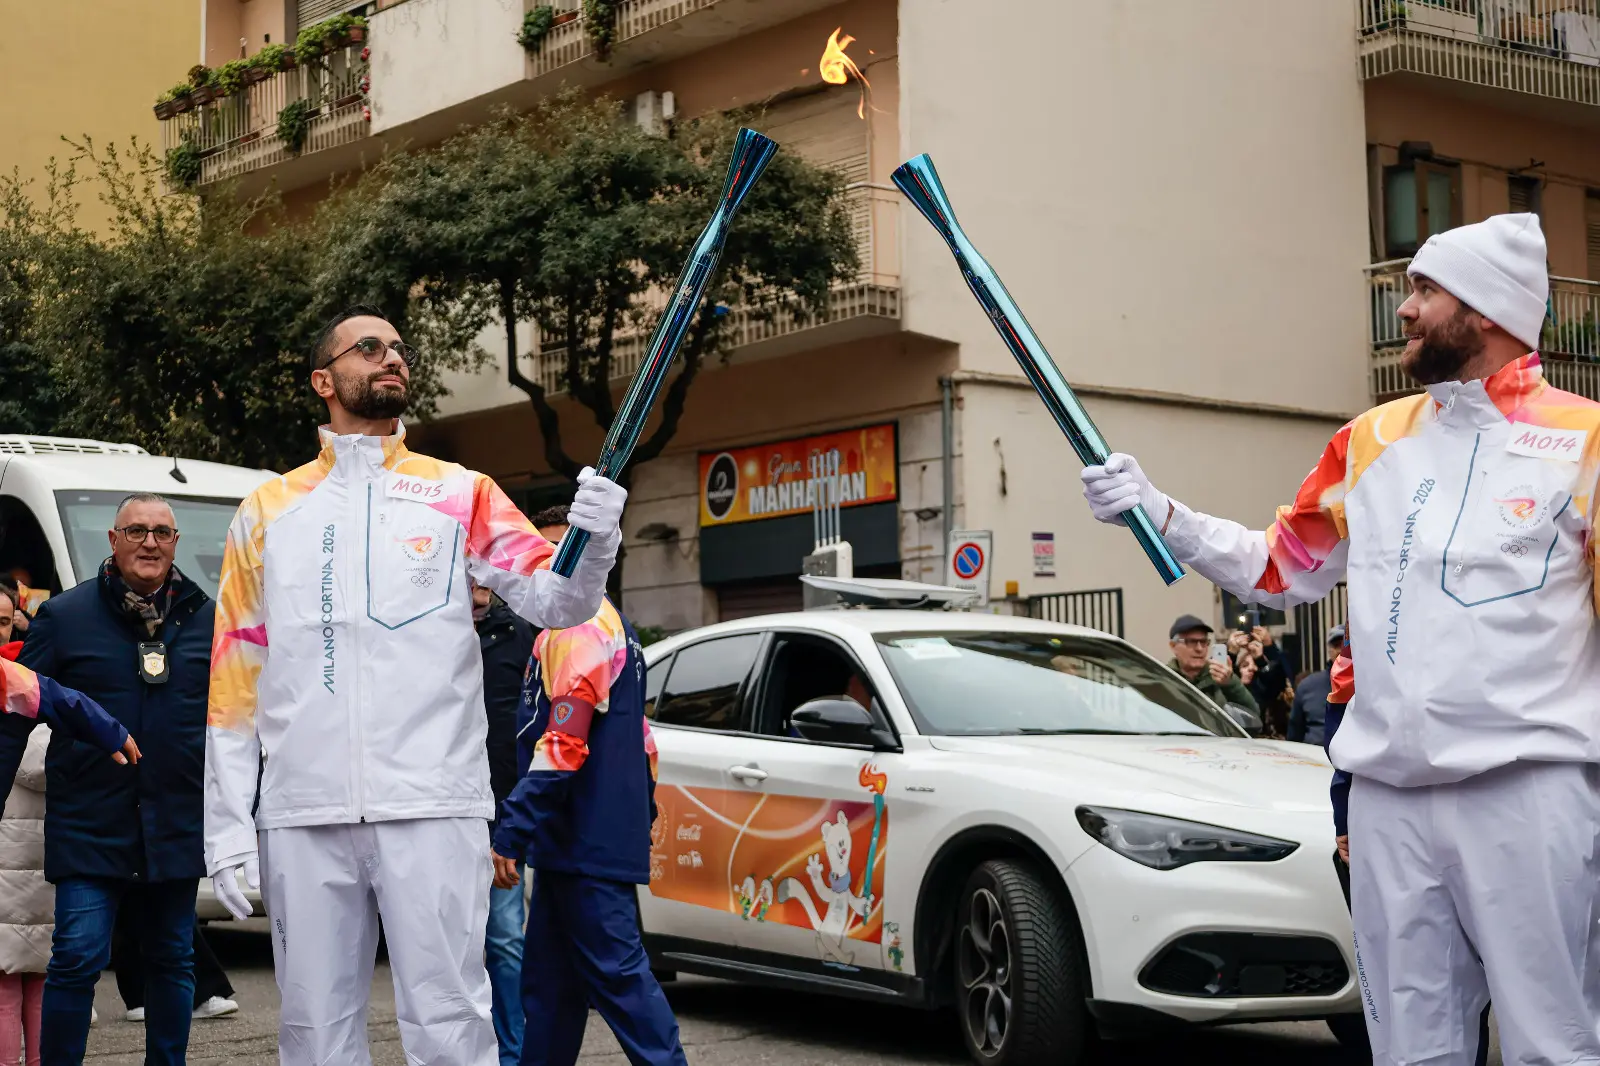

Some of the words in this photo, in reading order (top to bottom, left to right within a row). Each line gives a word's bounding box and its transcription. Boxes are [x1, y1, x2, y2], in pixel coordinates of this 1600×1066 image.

[322, 523, 335, 554] 2026
[1386, 586, 1402, 665] MILANO
[1396, 508, 1421, 583] CORTINA
[1412, 477, 1436, 505] 2026
[321, 557, 334, 625] CORTINA
[322, 626, 335, 695] MILANO
[1364, 988, 1381, 1024] MILANO
